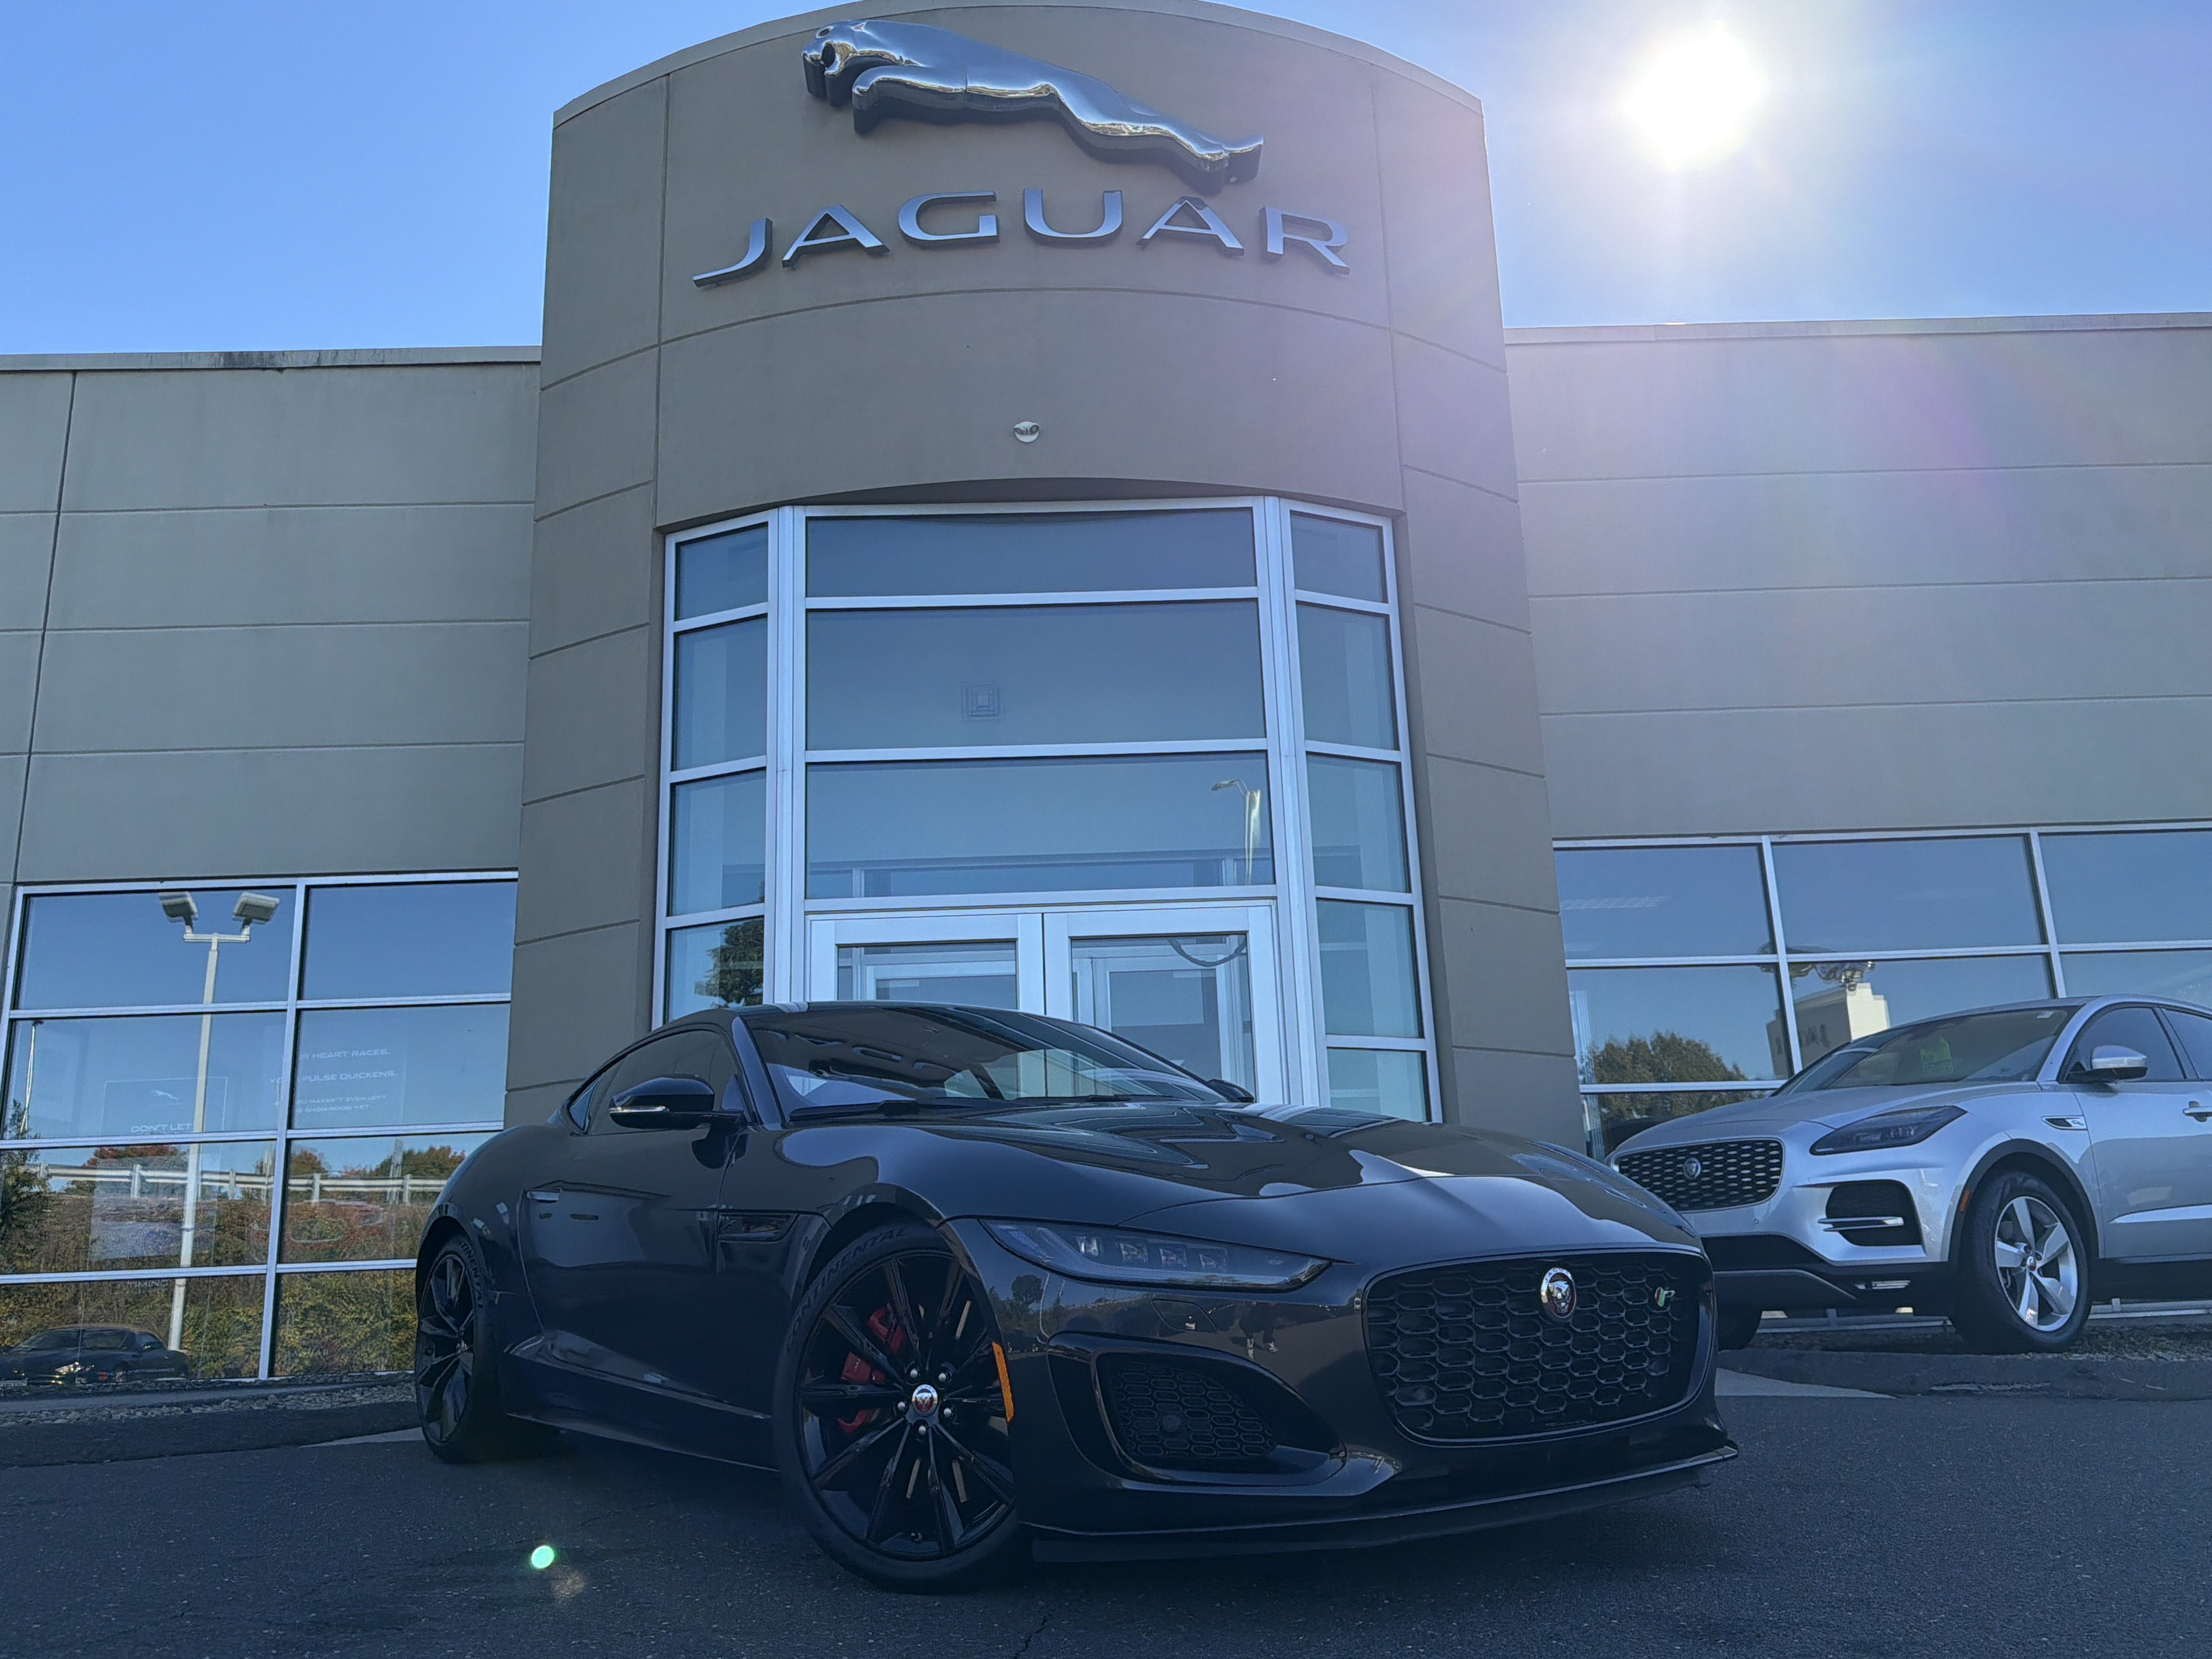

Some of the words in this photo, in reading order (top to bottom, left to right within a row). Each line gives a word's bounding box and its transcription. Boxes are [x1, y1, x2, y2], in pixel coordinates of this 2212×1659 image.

[692, 189, 1350, 287] JAGUAR
[312, 1051, 349, 1059] HEART
[351, 1048, 391, 1057] RACES.
[302, 1074, 337, 1082] PULSE
[340, 1070, 399, 1081] QUICKENS.
[131, 1124, 168, 1132] DON'T
[127, 1279, 170, 1288] TIMING
[786, 1228, 907, 1353] CONTINENTAL
